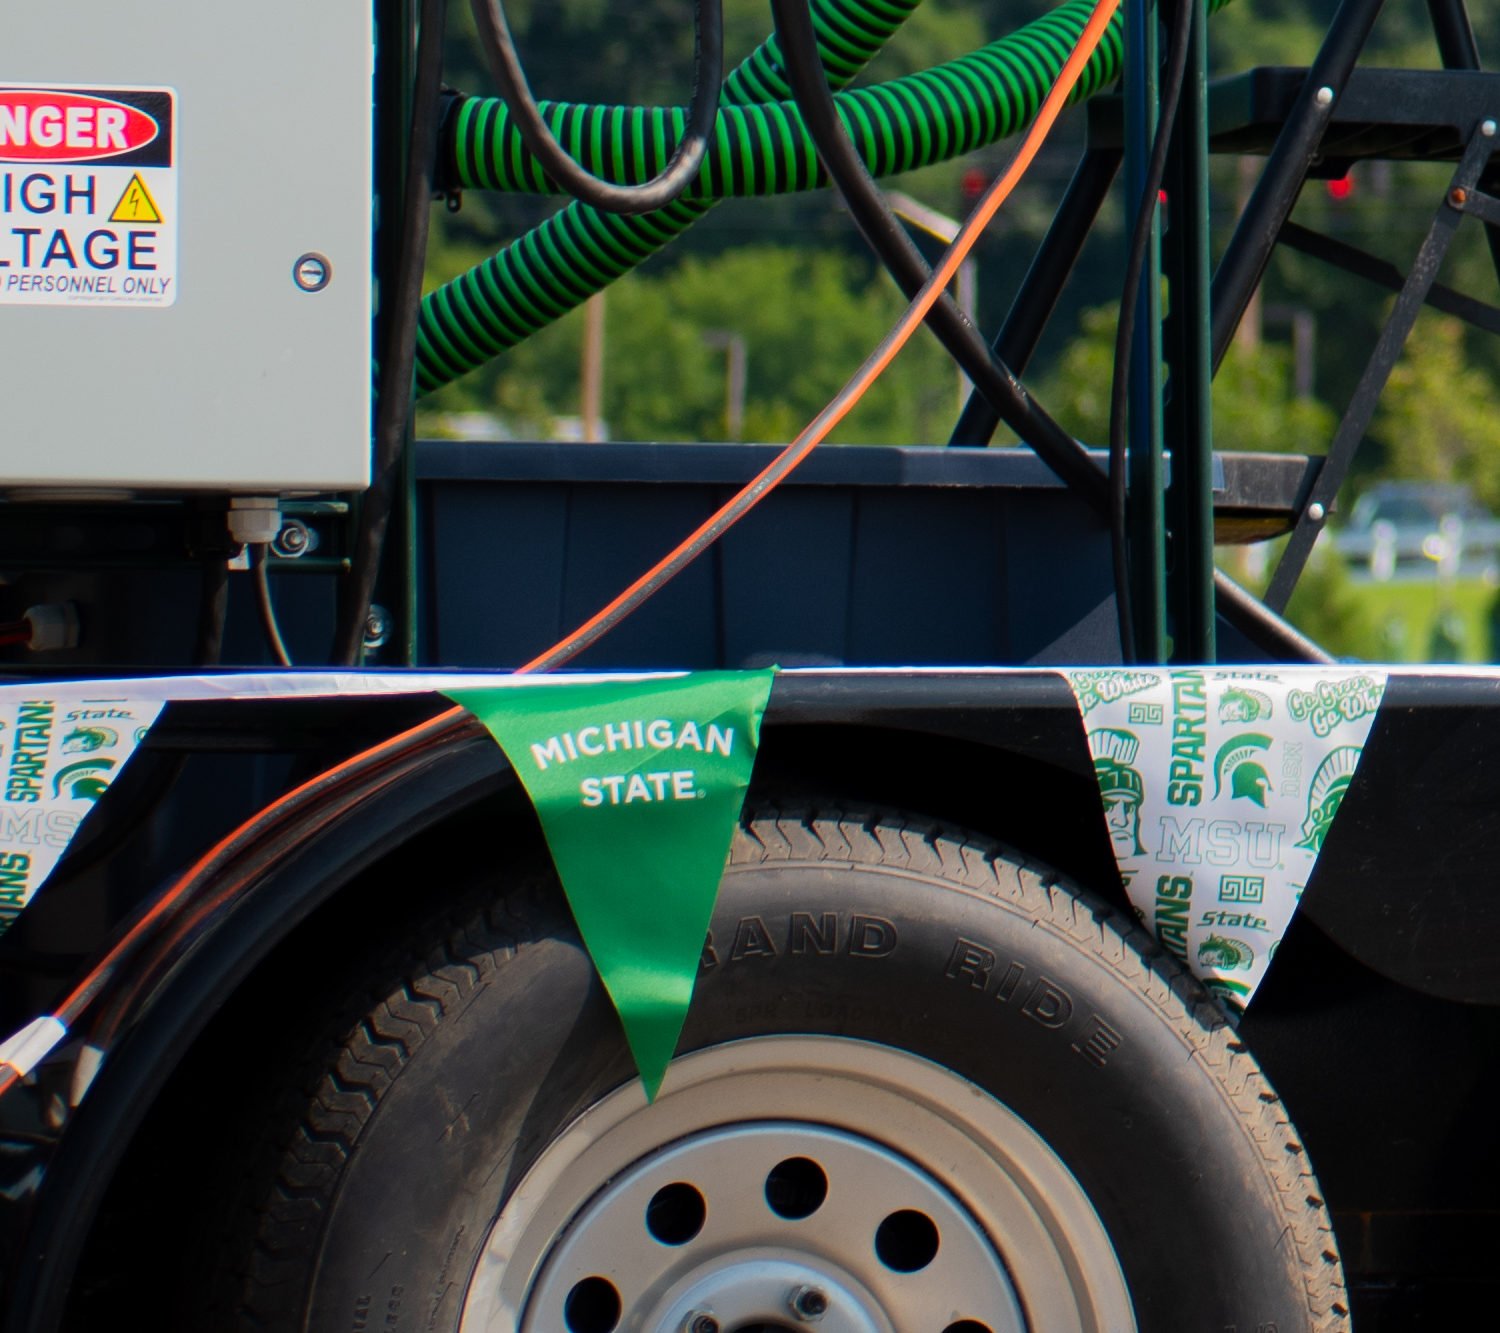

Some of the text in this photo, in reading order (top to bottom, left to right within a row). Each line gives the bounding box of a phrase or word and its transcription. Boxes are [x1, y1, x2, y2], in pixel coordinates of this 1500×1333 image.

[0, 105, 128, 149] NGER
[4, 173, 95, 215] IGH
[7, 274, 172, 295] PERSONNEL ONLY
[61, 708, 138, 724] State
[5, 700, 55, 803] SPARTAN
[527, 720, 733, 773] MICHIGAN
[580, 771, 695, 807] STATE
[0, 805, 83, 848] MS
[1155, 816, 1286, 869] MSU
[1196, 910, 1274, 934] State
[945, 935, 1124, 1068] RIDE
